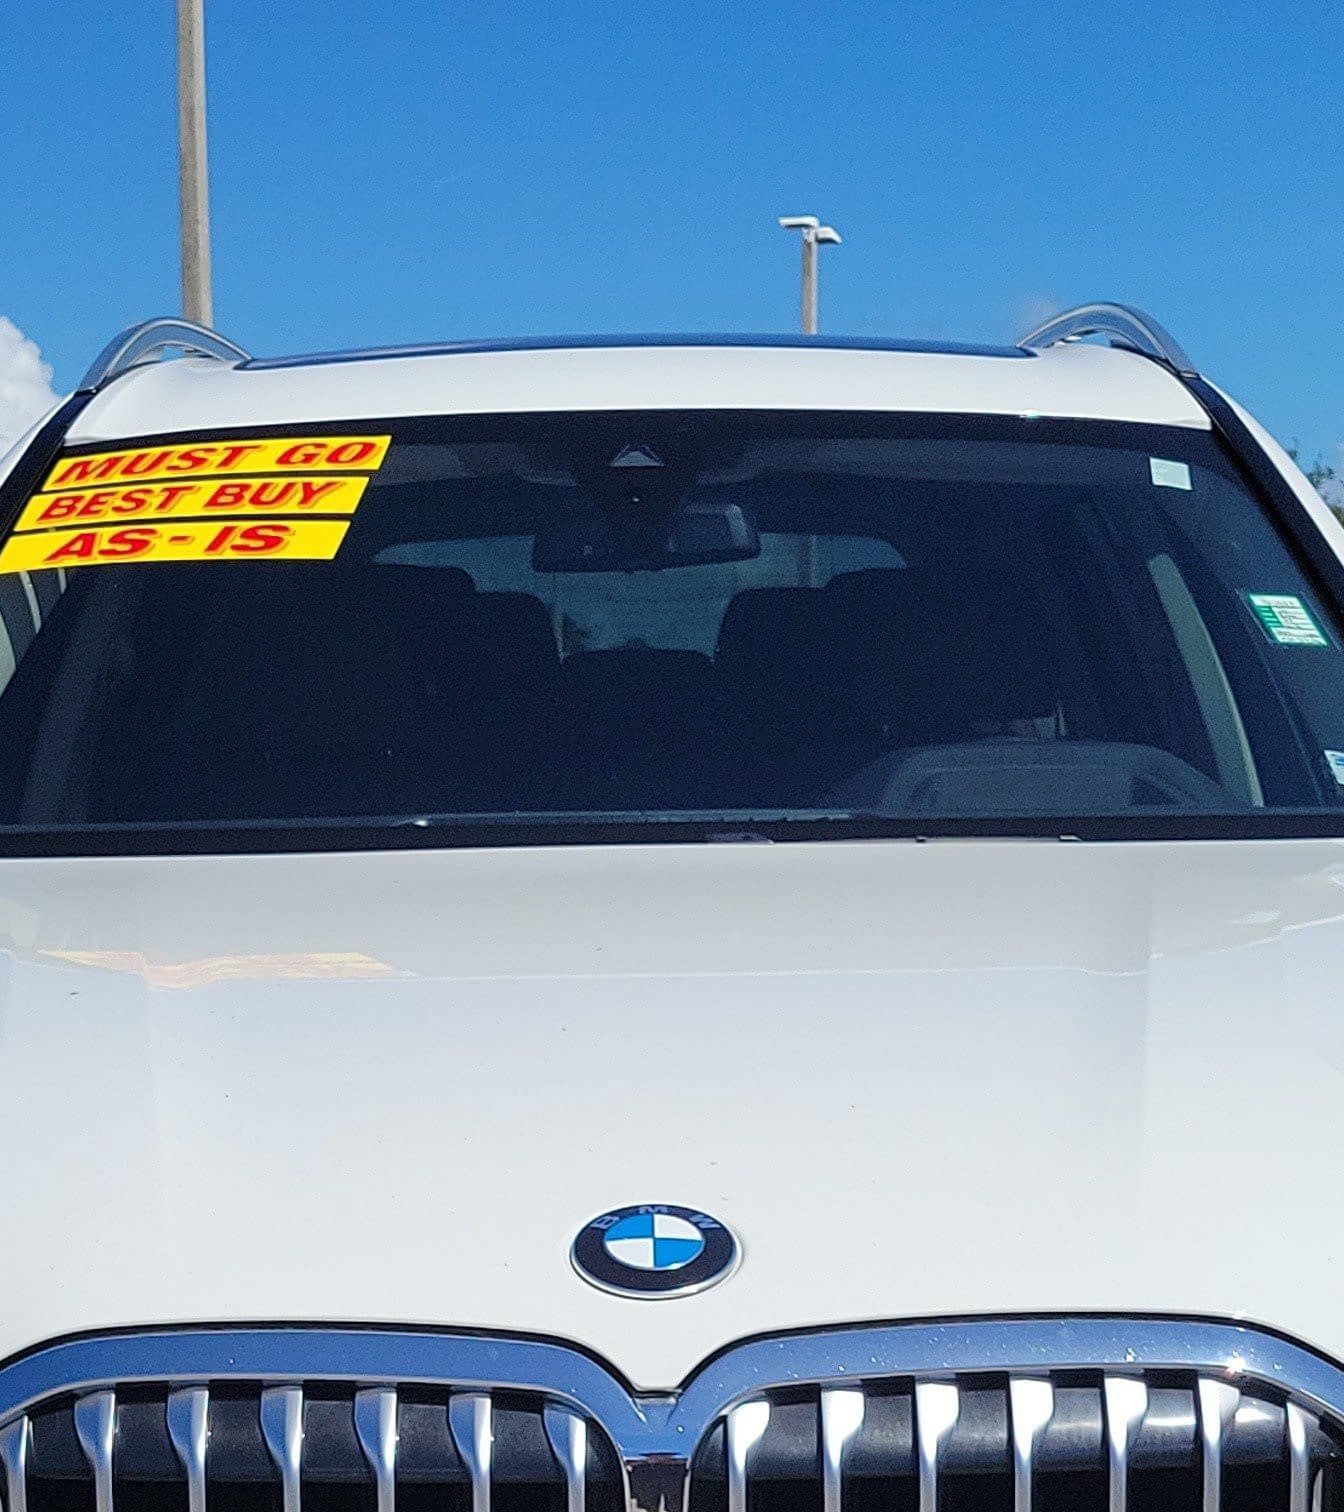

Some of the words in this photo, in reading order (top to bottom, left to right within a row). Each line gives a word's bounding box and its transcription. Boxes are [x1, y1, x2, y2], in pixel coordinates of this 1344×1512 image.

[53, 446, 261, 485] MUST
[275, 440, 379, 467] GO
[36, 485, 199, 523] BEST
[202, 480, 346, 510] BUY
[590, 1205, 722, 1230] BMW
